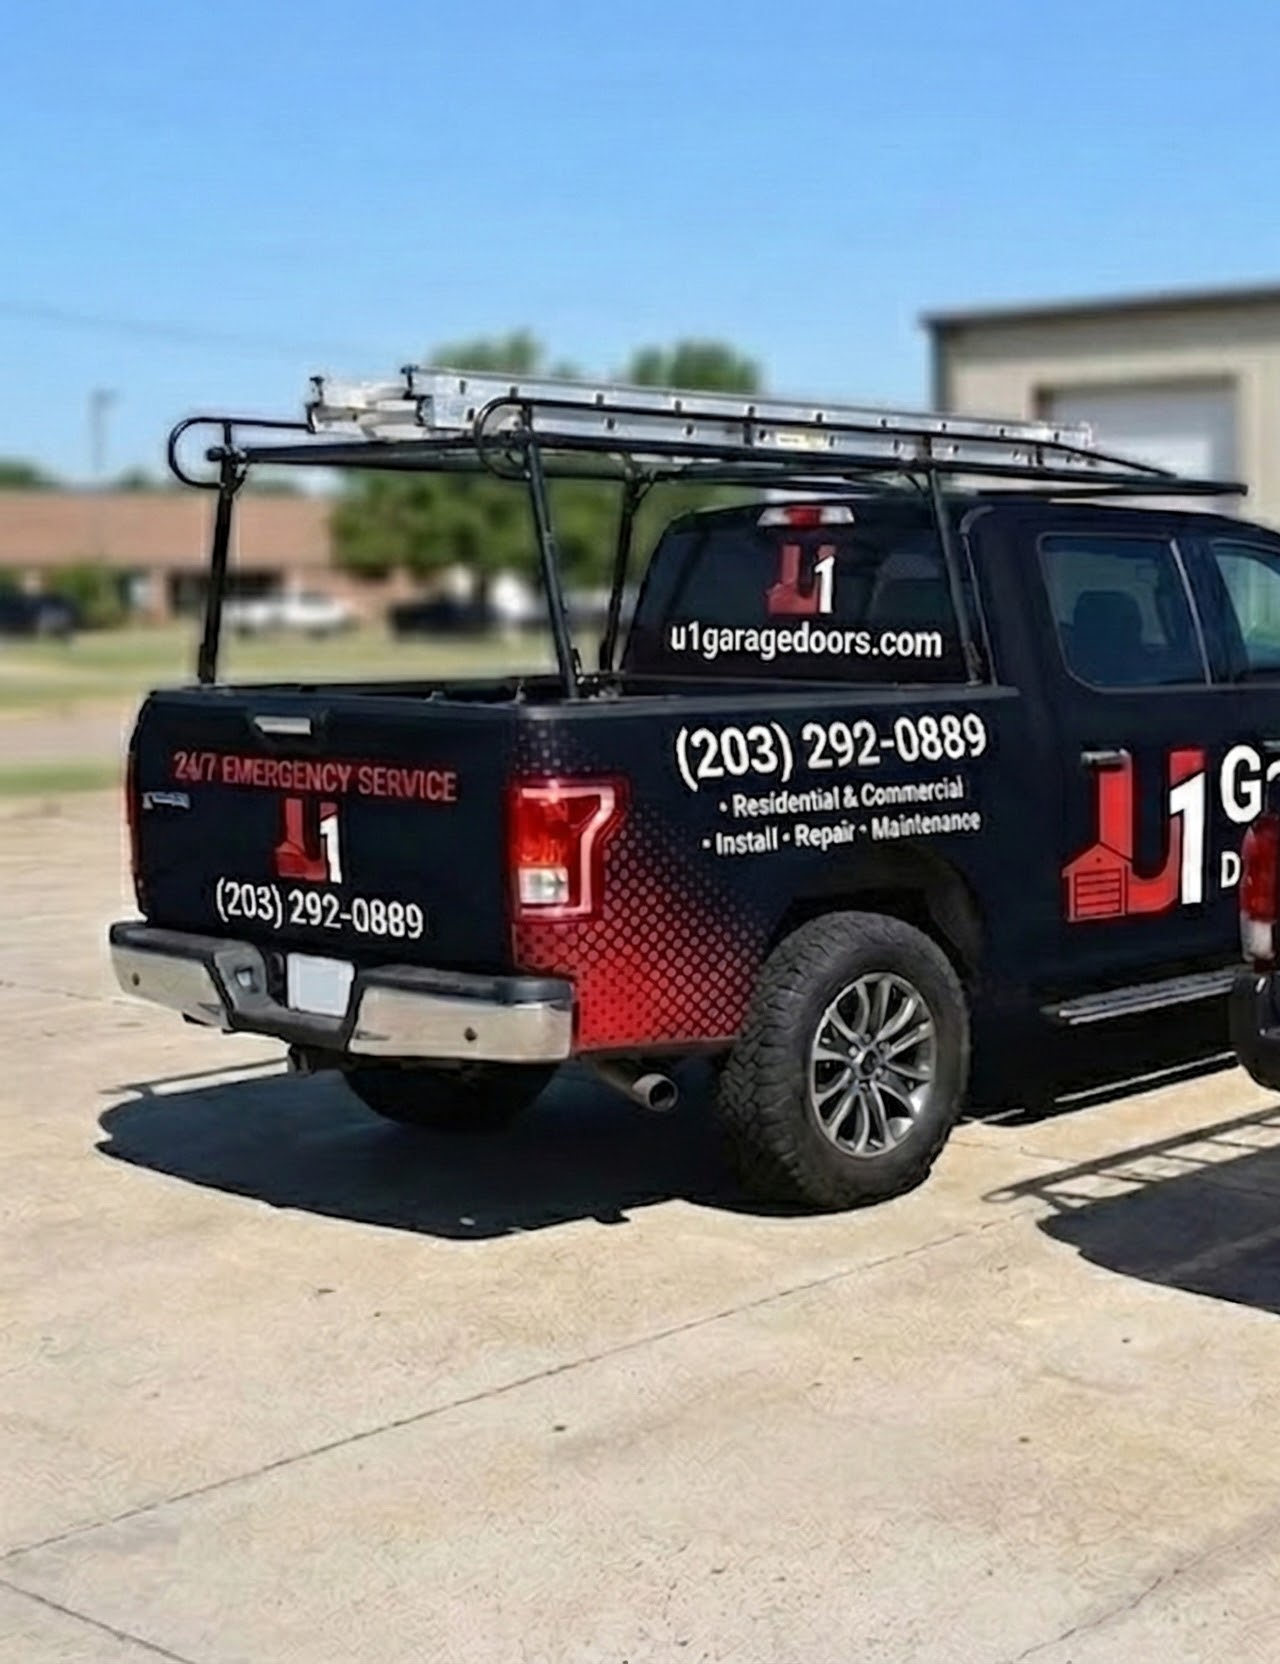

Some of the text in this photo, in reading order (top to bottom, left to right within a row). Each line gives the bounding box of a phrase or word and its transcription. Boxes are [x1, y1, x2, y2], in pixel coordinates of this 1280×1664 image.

[671, 622, 942, 659] u1garagedoors.com
[174, 751, 457, 801] 24/7 EMERGENCY SERVICE
[676, 713, 987, 790] (203) 292-0889
[732, 776, 964, 818] Residential & Commercial
[715, 811, 981, 856] Install Repair Maintenance
[1062, 748, 1206, 922] U1
[215, 876, 424, 940] (203) 292-0889
